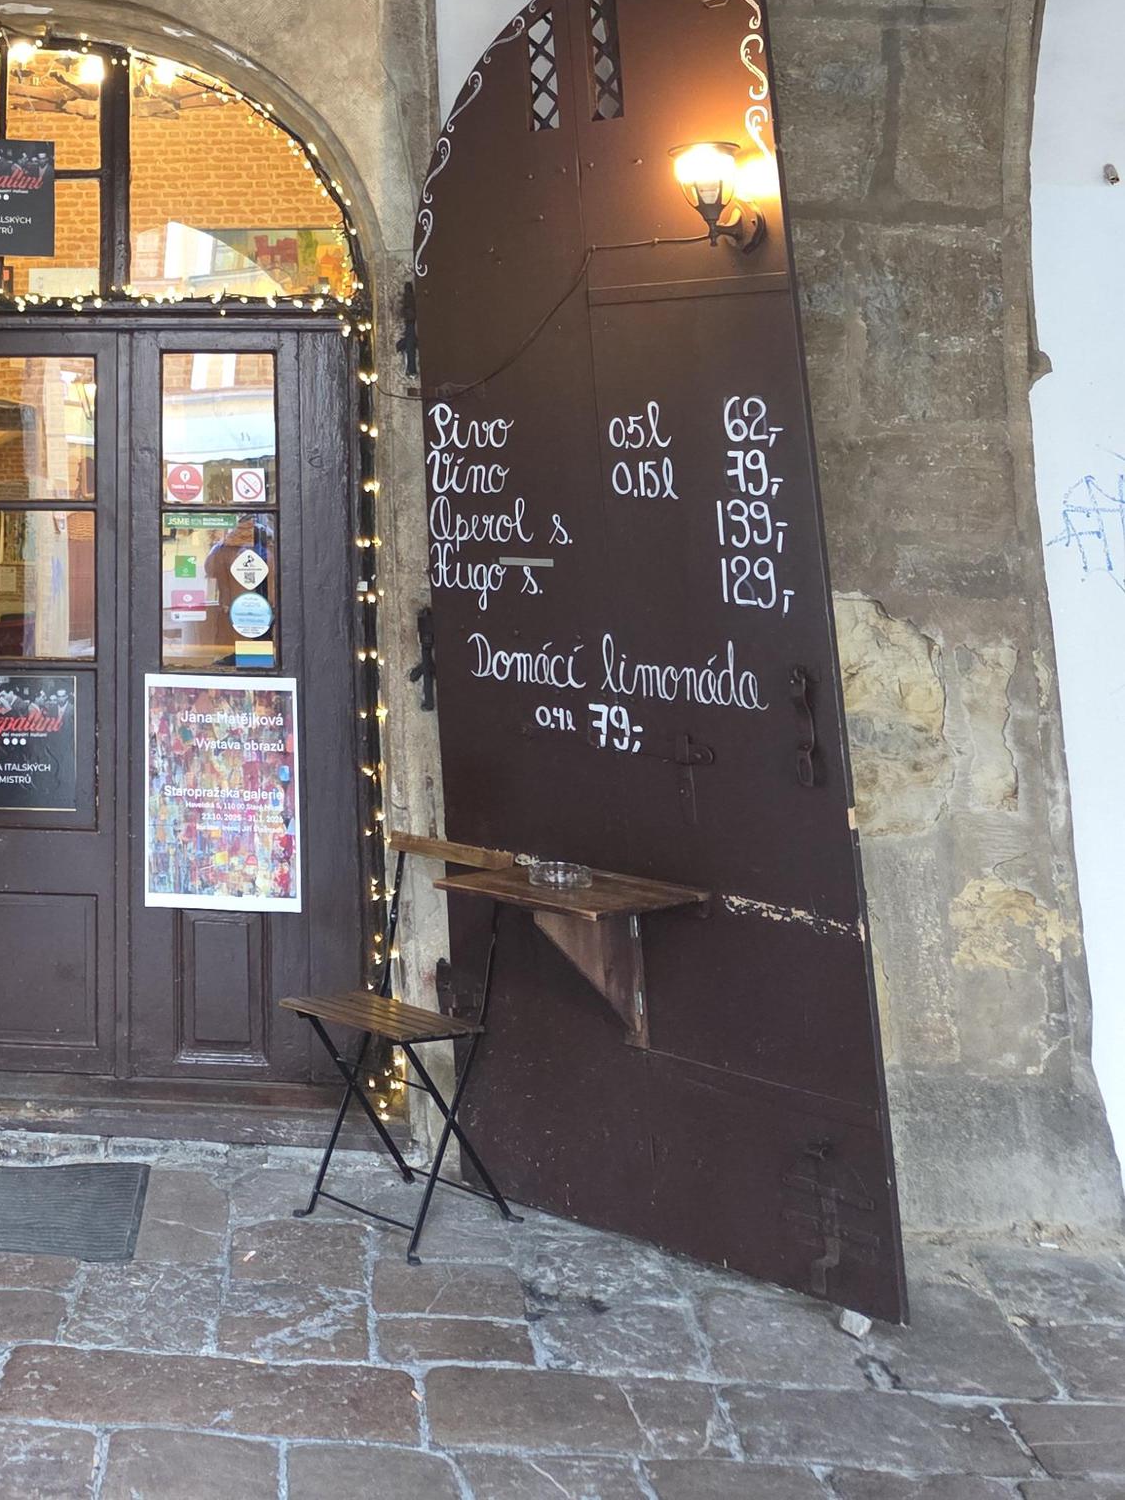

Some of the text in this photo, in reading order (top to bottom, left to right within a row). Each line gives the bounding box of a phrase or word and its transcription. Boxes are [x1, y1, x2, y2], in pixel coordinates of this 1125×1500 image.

[428, 403, 514, 450] Pivo
[724, 396, 784, 447] 62,-
[426, 450, 510, 493] Víno
[726, 449, 784, 497] 79,-
[429, 495, 788, 553] Aperol s. 139,-
[430, 542, 507, 611] Hugo
[721, 555, 795, 614] 129,-
[467, 633, 769, 711] Domácí limonáda
[180, 710, 212, 724] Jana
[4, 762, 51, 772] ITALSKÝCH
[196, 737, 284, 752] Výstava obrazů
[163, 784, 284, 802] Staropražská galerie
